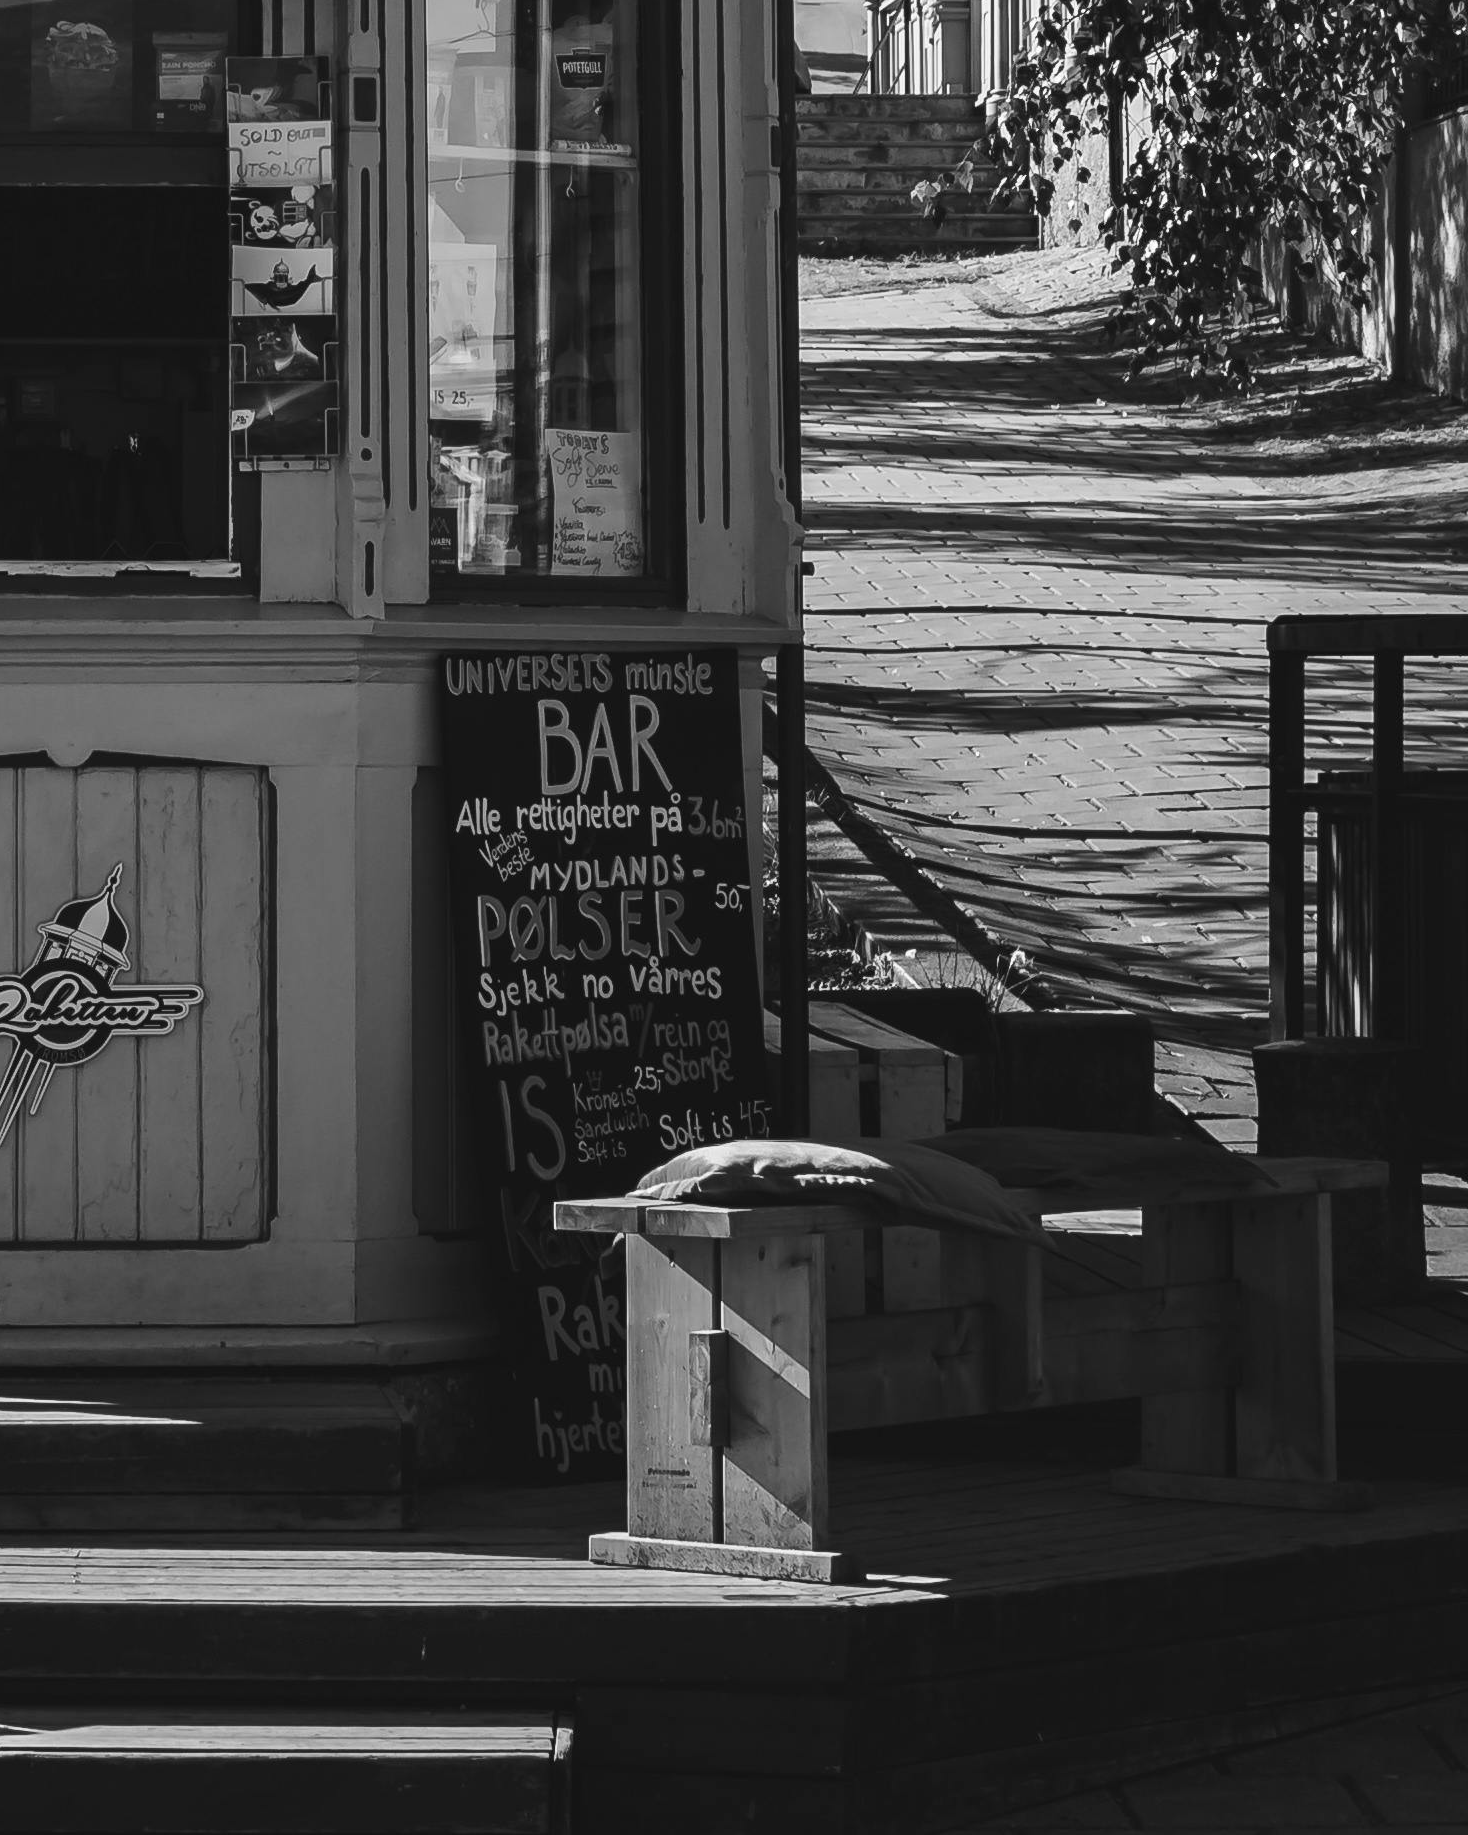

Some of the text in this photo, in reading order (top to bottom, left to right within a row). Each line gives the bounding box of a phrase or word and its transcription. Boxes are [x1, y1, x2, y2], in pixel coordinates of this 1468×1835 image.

[562, 61, 603, 74] POTETGULL
[240, 128, 282, 147] SOLD
[446, 653, 713, 695] UNIVERSETS minste
[538, 694, 673, 795] BAR
[456, 797, 501, 836] Alle
[516, 790, 639, 845] rettigheter
[650, 792, 683, 847] på
[479, 829, 528, 868] Verdens
[496, 847, 534, 882] beste
[715, 882, 751, 913] 50,-
[478, 889, 702, 968] PØLSER
[478, 966, 565, 1017] Sjekk
[582, 972, 614, 999] no
[483, 1002, 629, 1078] Rakettpølsa
[653, 1014, 701, 1049] rein
[706, 1019, 731, 1062] og
[572, 1082, 637, 1115] Kroneis
[634, 1065, 664, 1094] 25,-
[499, 1074, 566, 1181] IS
[659, 1100, 772, 1151] Soft is 45,-
[534, 1397, 626, 1474] hjerte
